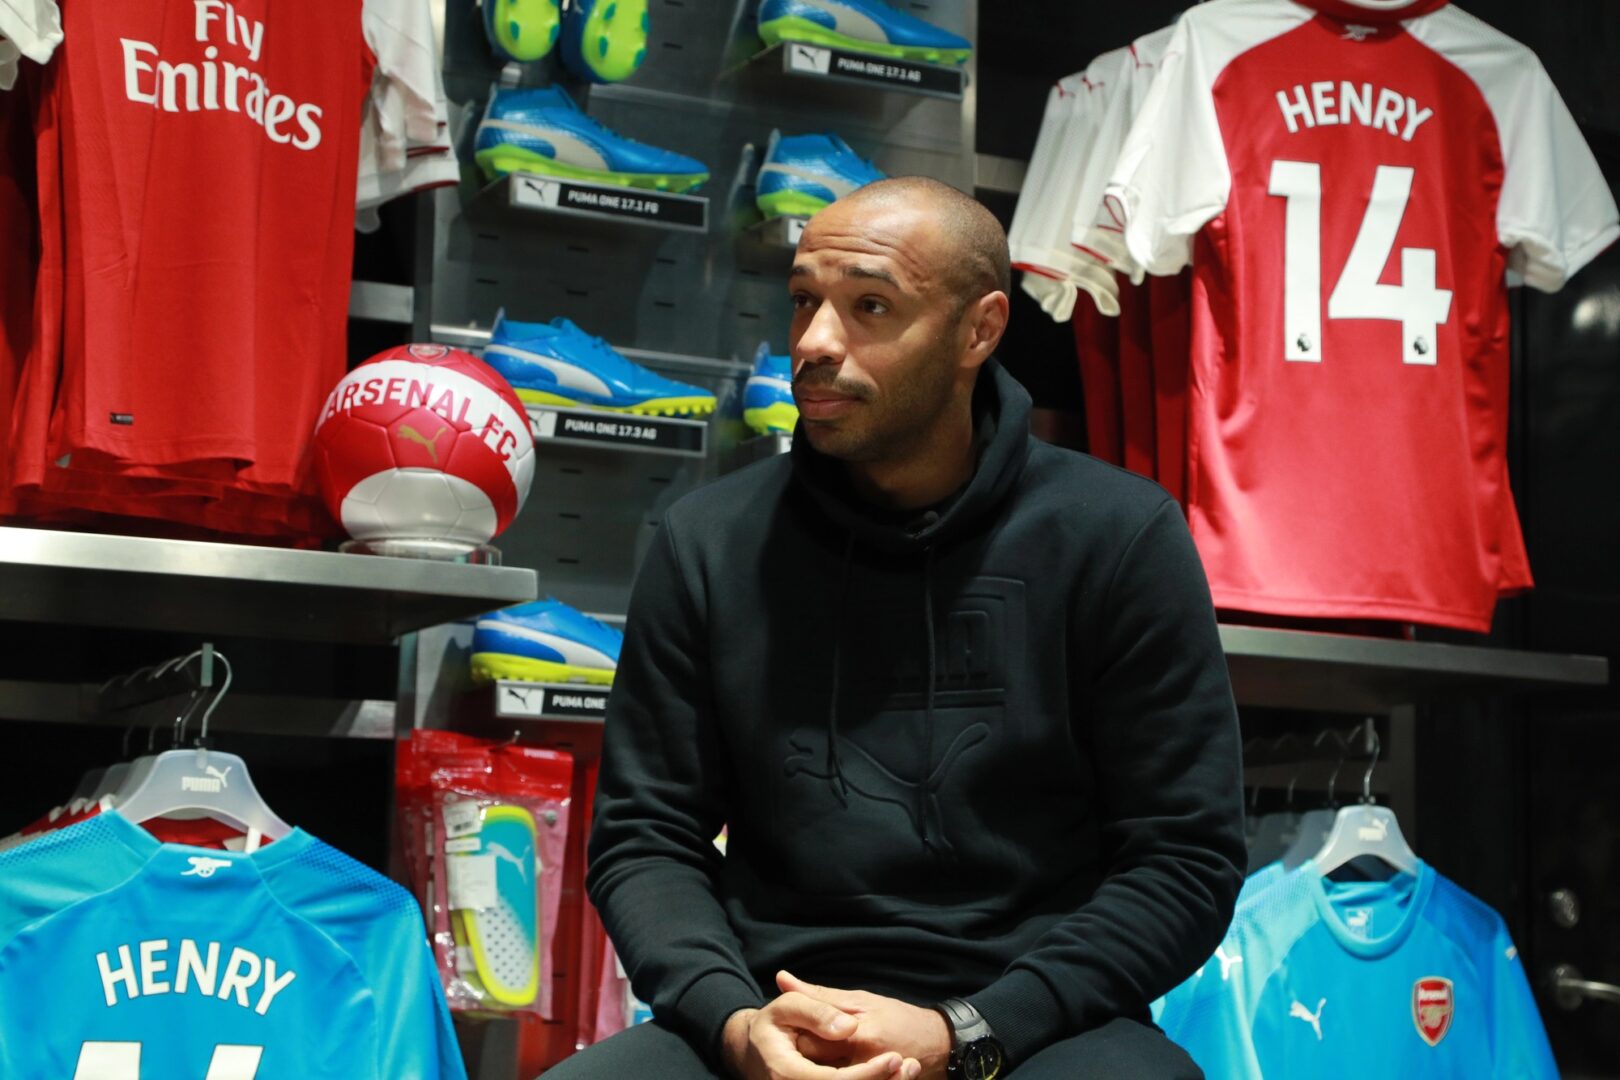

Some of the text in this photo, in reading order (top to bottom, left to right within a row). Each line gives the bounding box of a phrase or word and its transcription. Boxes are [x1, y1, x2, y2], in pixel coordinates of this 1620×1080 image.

[194, 0, 264, 62] Fly
[837, 57, 865, 72] PUMA
[865, 62, 885, 76] ONE
[120, 38, 323, 150] Emiraes
[1275, 81, 1433, 141] HENRY
[567, 189, 659, 215] PUMA ONE 17.1 FG
[1268, 160, 1453, 365] 14
[478, 413, 518, 462] FC
[564, 418, 657, 441] PUMA ONE 17.3 AG
[552, 694, 606, 710] PUMA ONE
[96, 938, 296, 1016] HENRY
